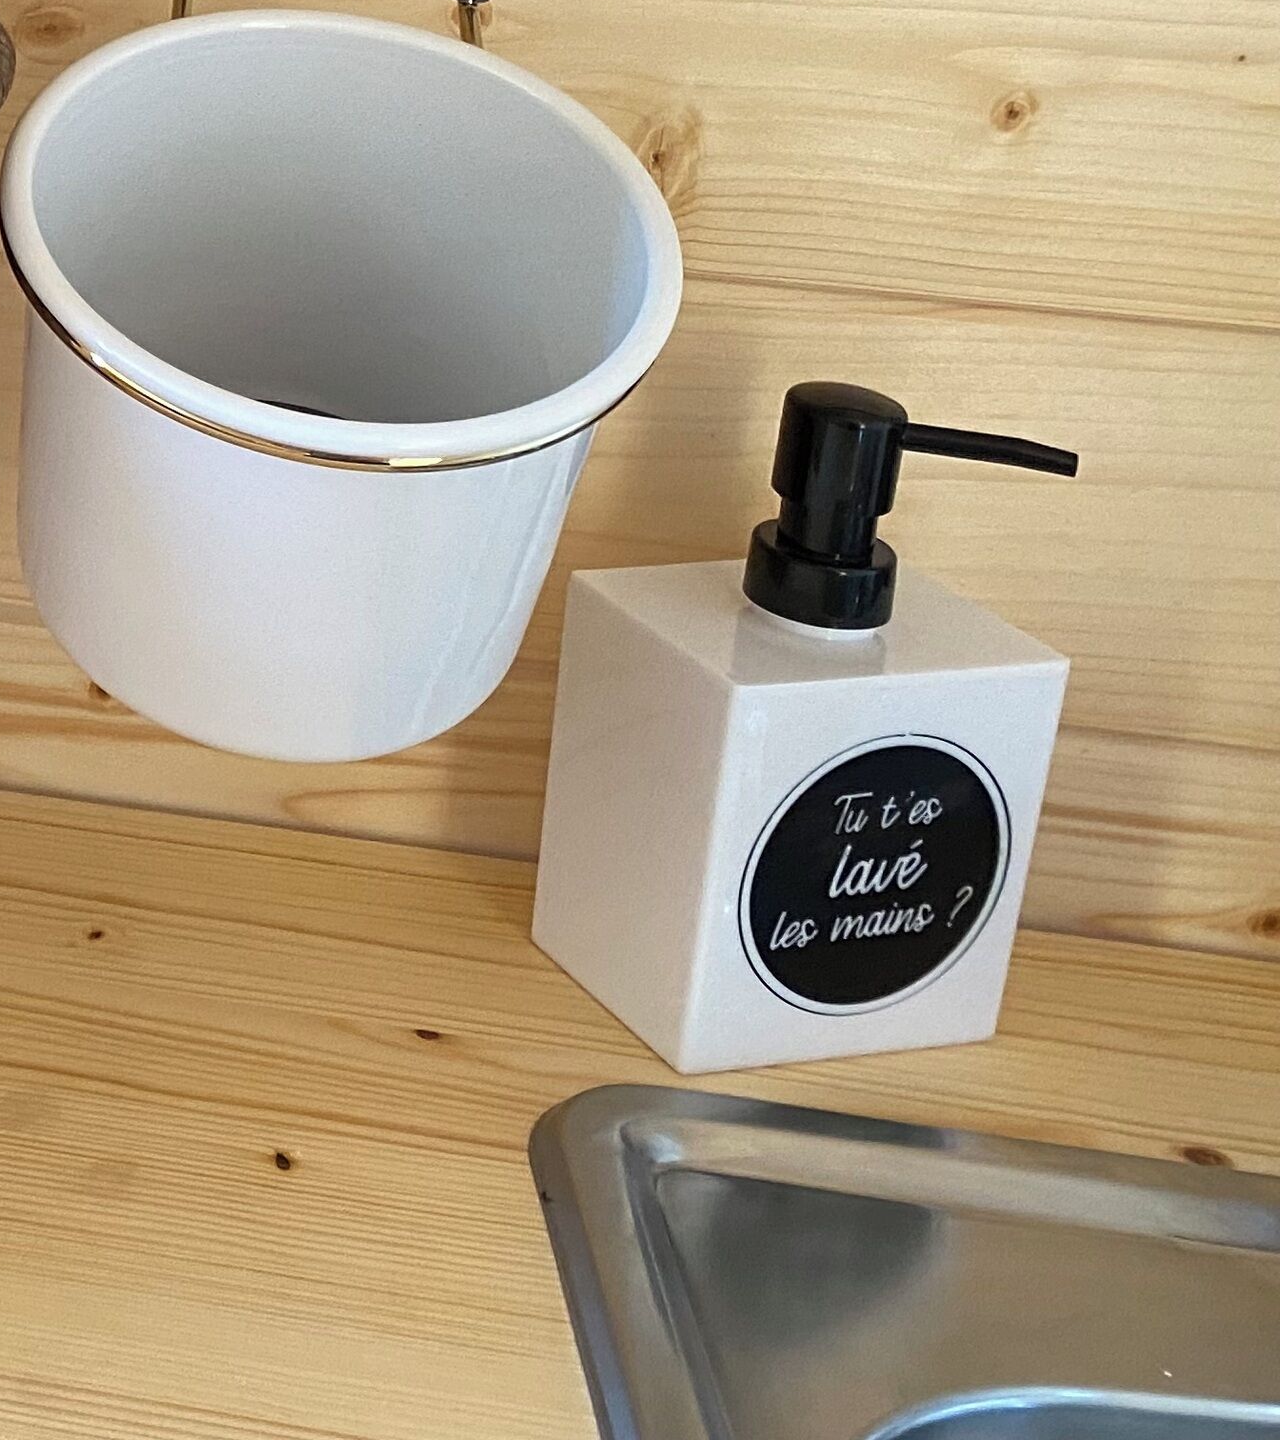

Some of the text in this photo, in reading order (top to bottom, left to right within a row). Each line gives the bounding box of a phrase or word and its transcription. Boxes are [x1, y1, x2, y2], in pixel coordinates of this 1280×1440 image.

[833, 791, 873, 835] Tu
[828, 839, 928, 899] lavé
[769, 885, 974, 951] les mains ?
